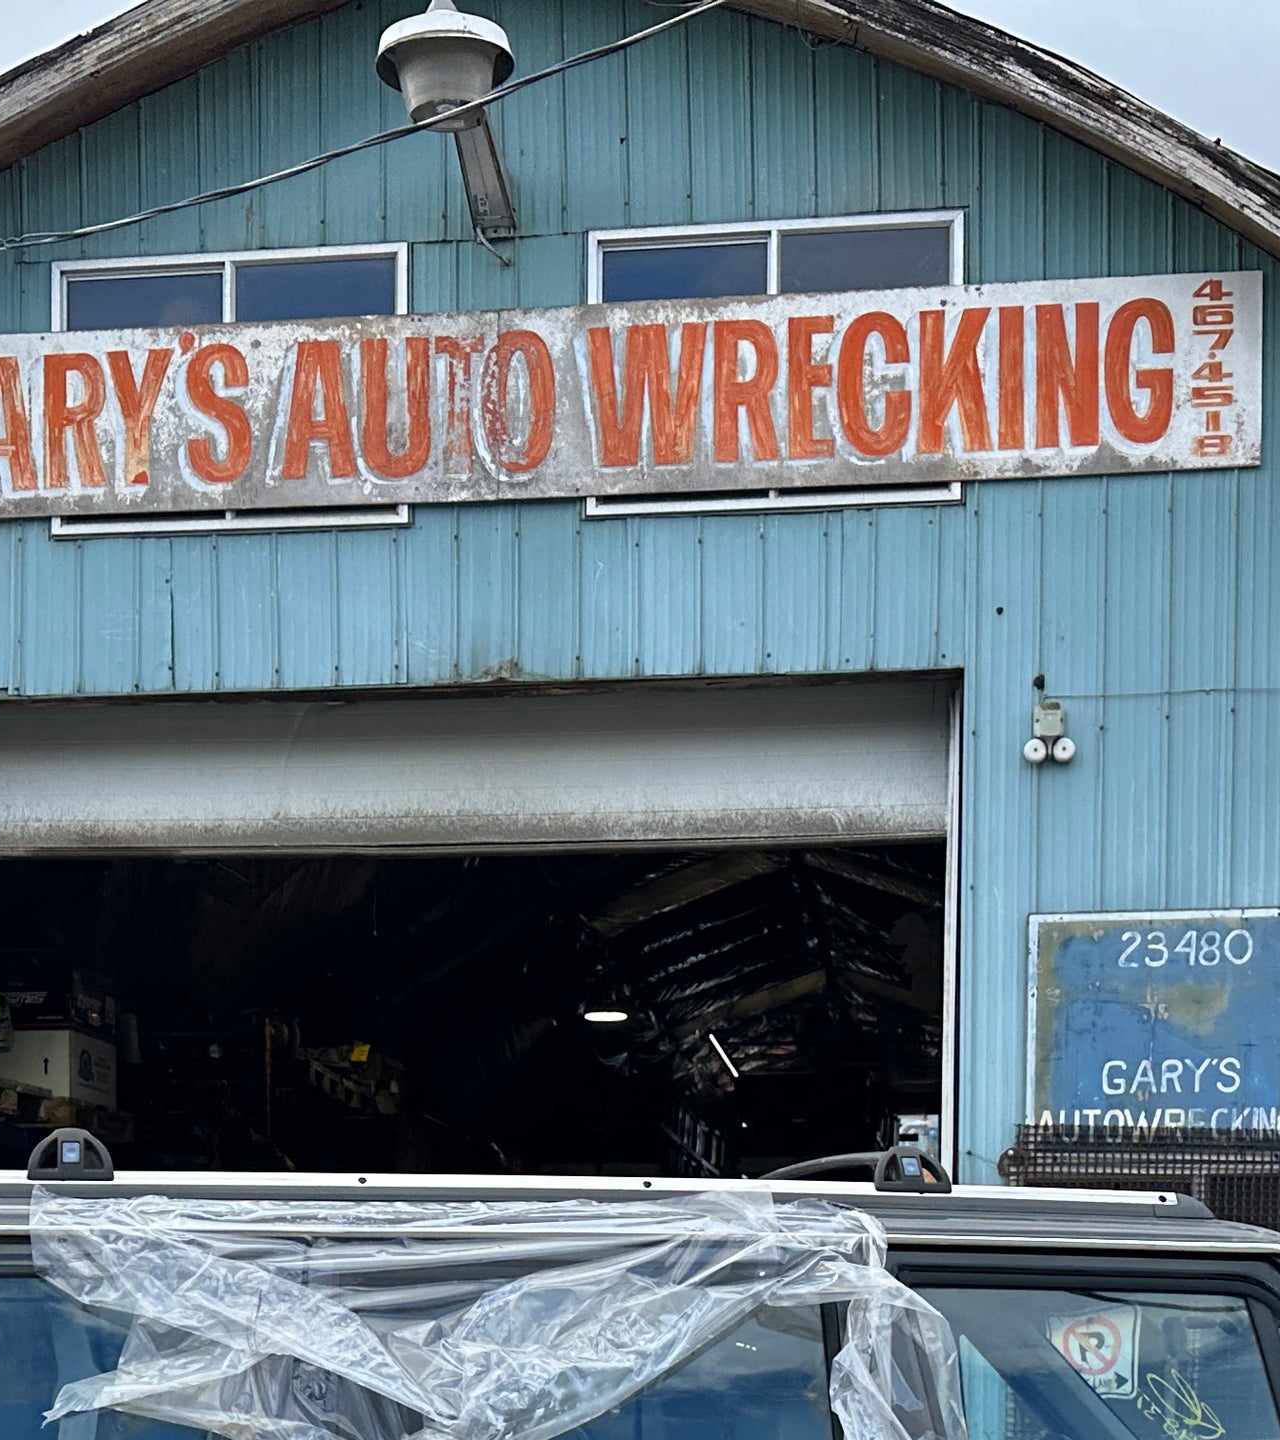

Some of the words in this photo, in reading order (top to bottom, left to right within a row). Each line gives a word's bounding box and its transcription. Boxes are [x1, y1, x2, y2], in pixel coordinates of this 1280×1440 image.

[282, 330, 556, 480] AUTO
[587, 297, 1175, 467] WRECKING
[1118, 929, 1254, 968] 23480
[1101, 1057, 1242, 1095] GARY'S
